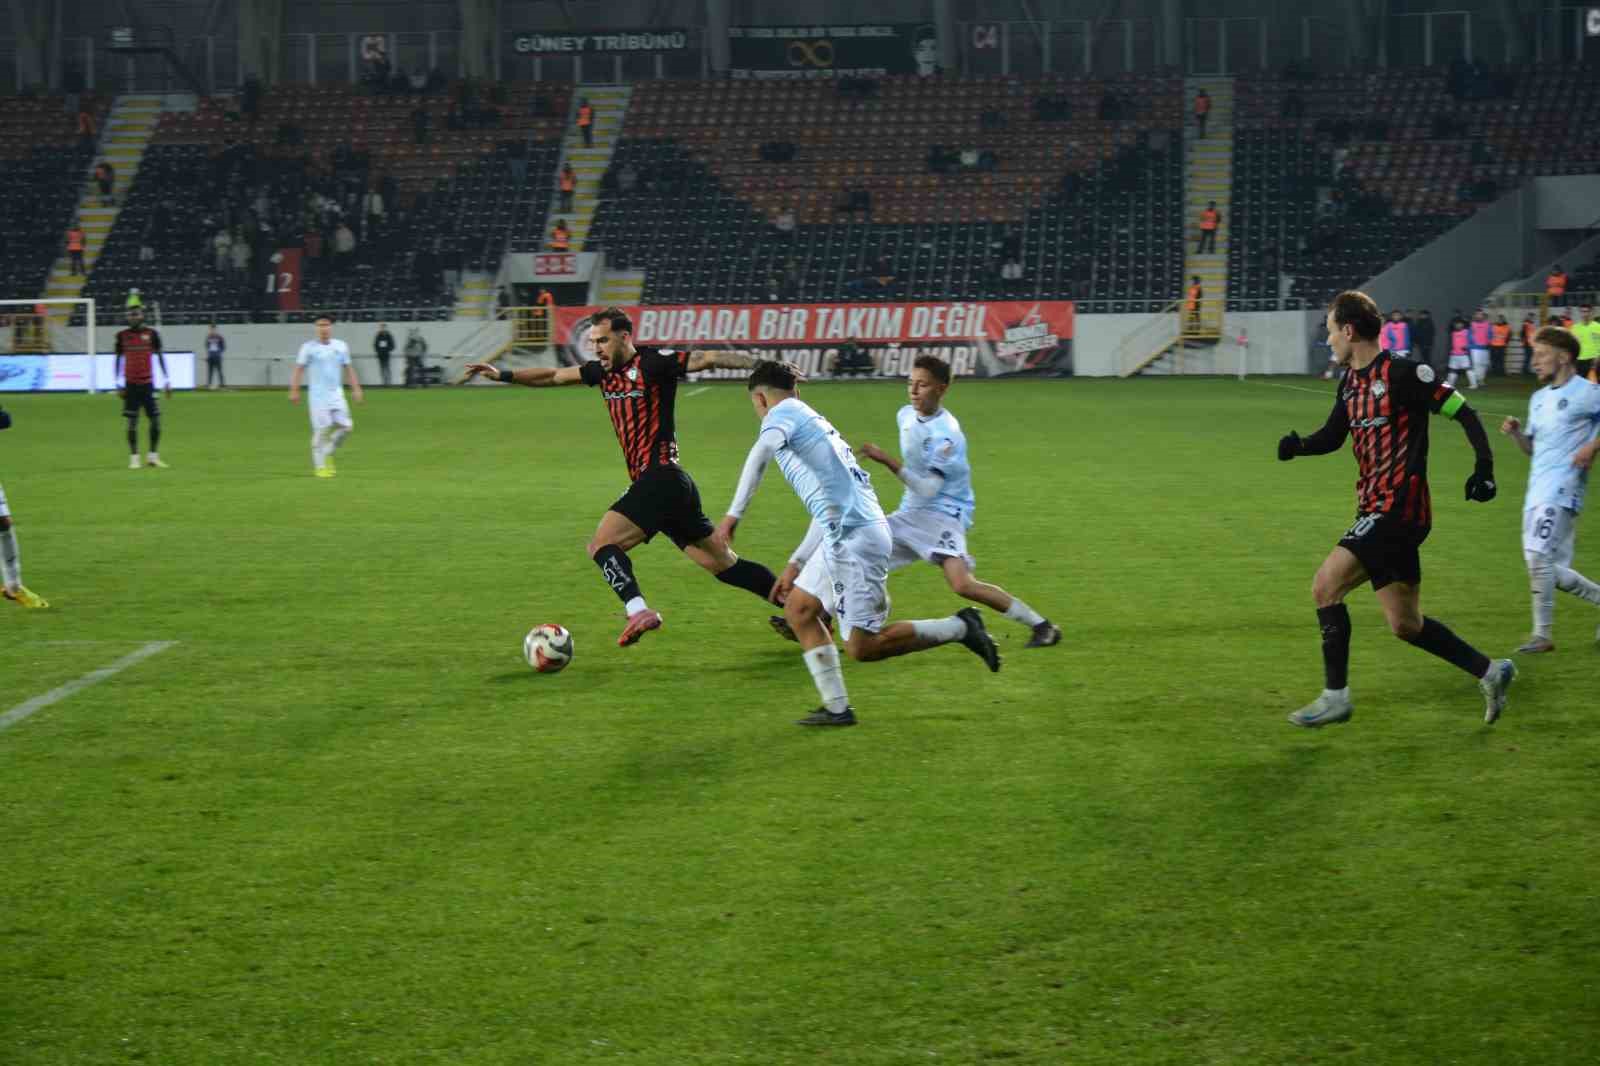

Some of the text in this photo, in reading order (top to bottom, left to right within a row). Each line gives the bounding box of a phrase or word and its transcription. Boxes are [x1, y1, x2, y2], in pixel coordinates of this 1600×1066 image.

[515, 32, 686, 52] GÜNEY TRİBÜNÜ
[638, 310, 750, 340] BURADA
[815, 308, 904, 338] TAKIM
